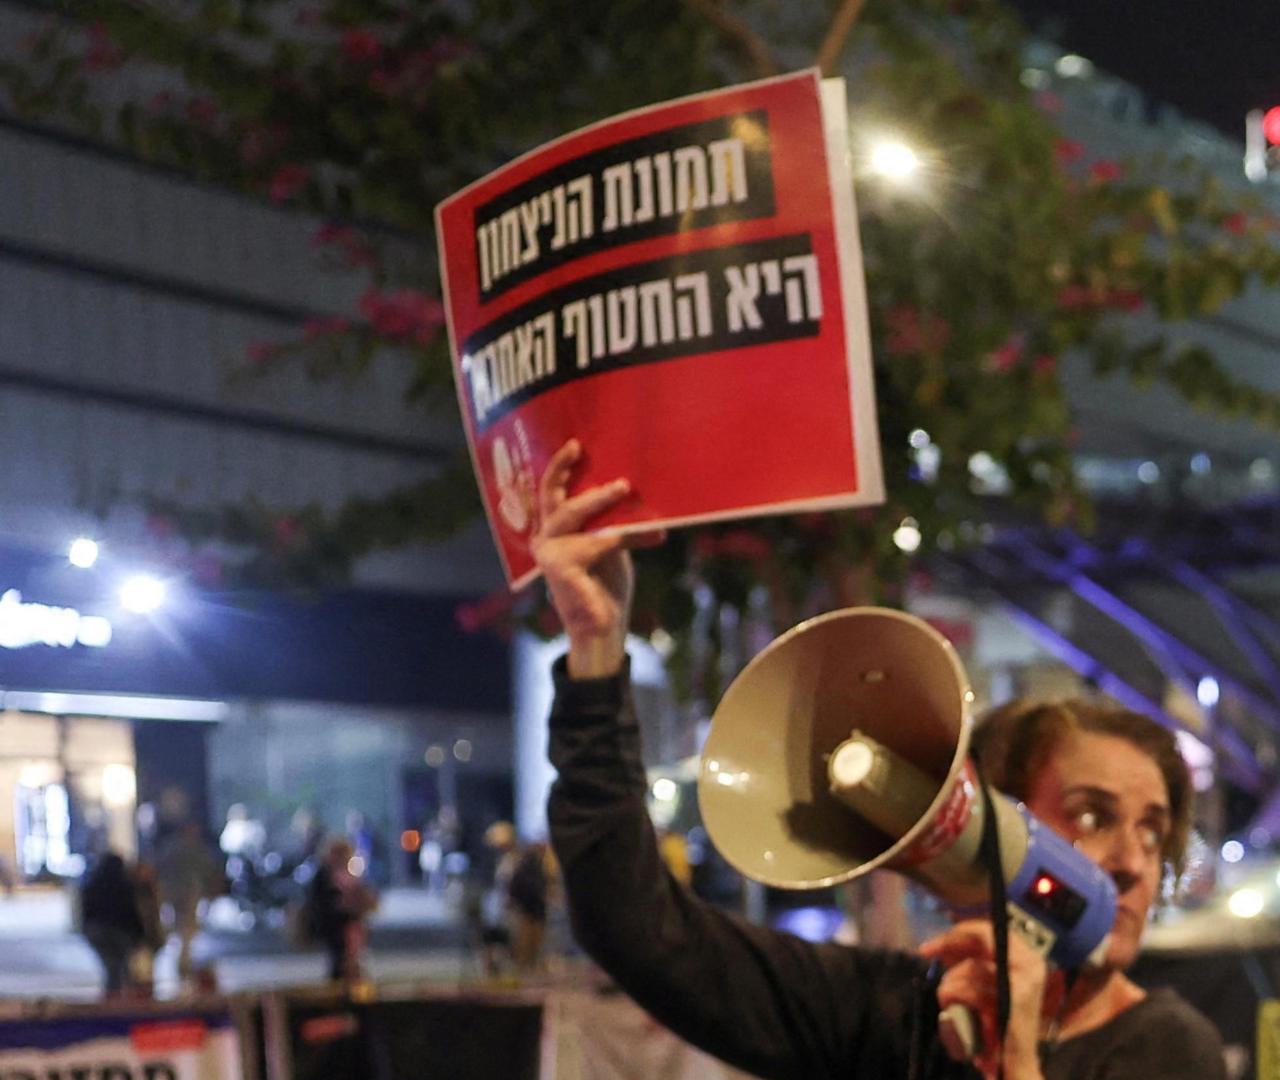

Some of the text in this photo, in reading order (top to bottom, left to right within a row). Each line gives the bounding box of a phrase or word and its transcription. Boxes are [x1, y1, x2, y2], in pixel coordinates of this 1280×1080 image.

[475, 136, 749, 293] תמונת הניצחון
[469, 252, 824, 423] היא החטוף האחרון
